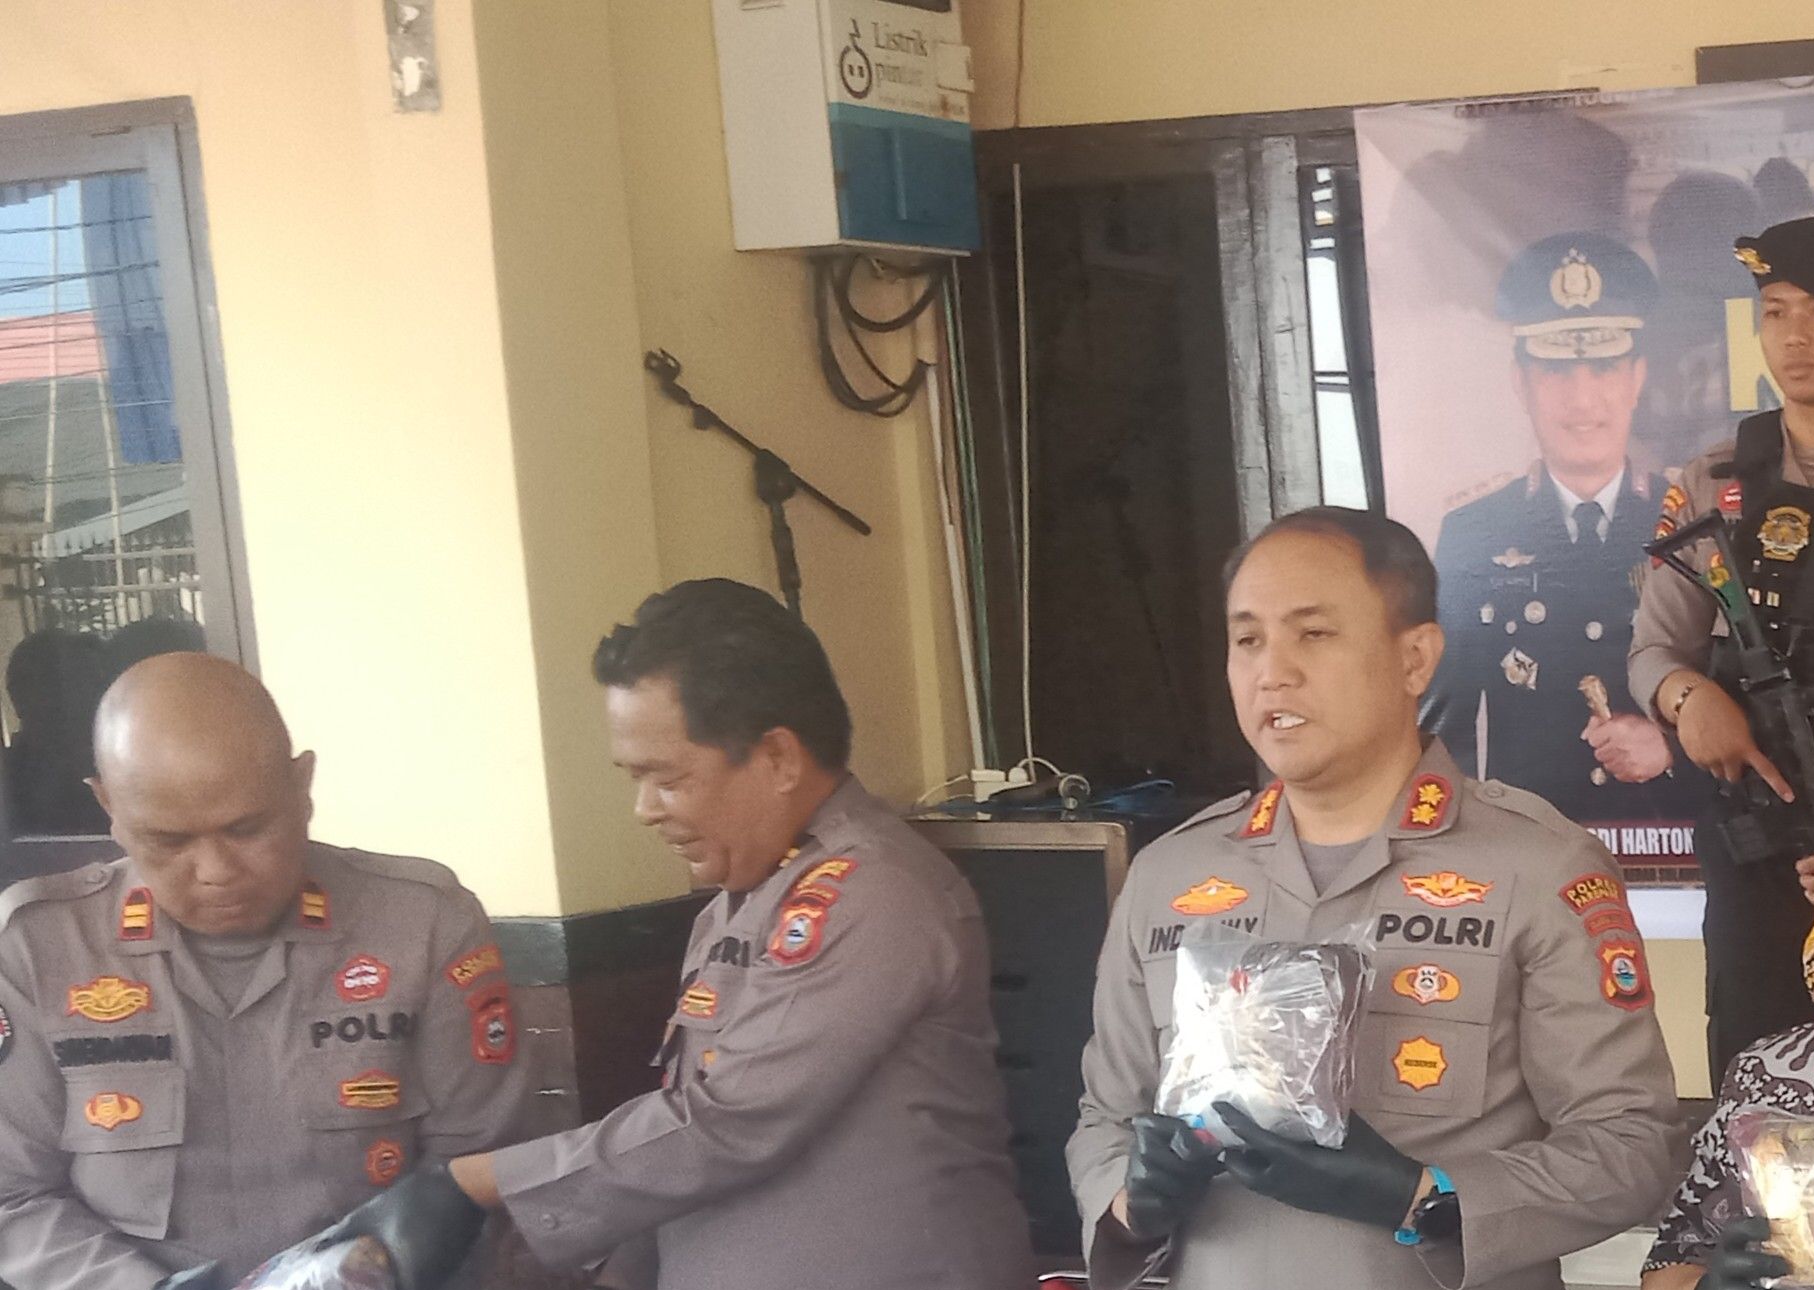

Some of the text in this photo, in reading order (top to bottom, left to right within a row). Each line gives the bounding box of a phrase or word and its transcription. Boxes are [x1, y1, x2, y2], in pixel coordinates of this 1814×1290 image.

[1621, 827, 1695, 855] HARTON
[1148, 924, 1186, 954] IND
[1377, 914, 1495, 948] POLRI
